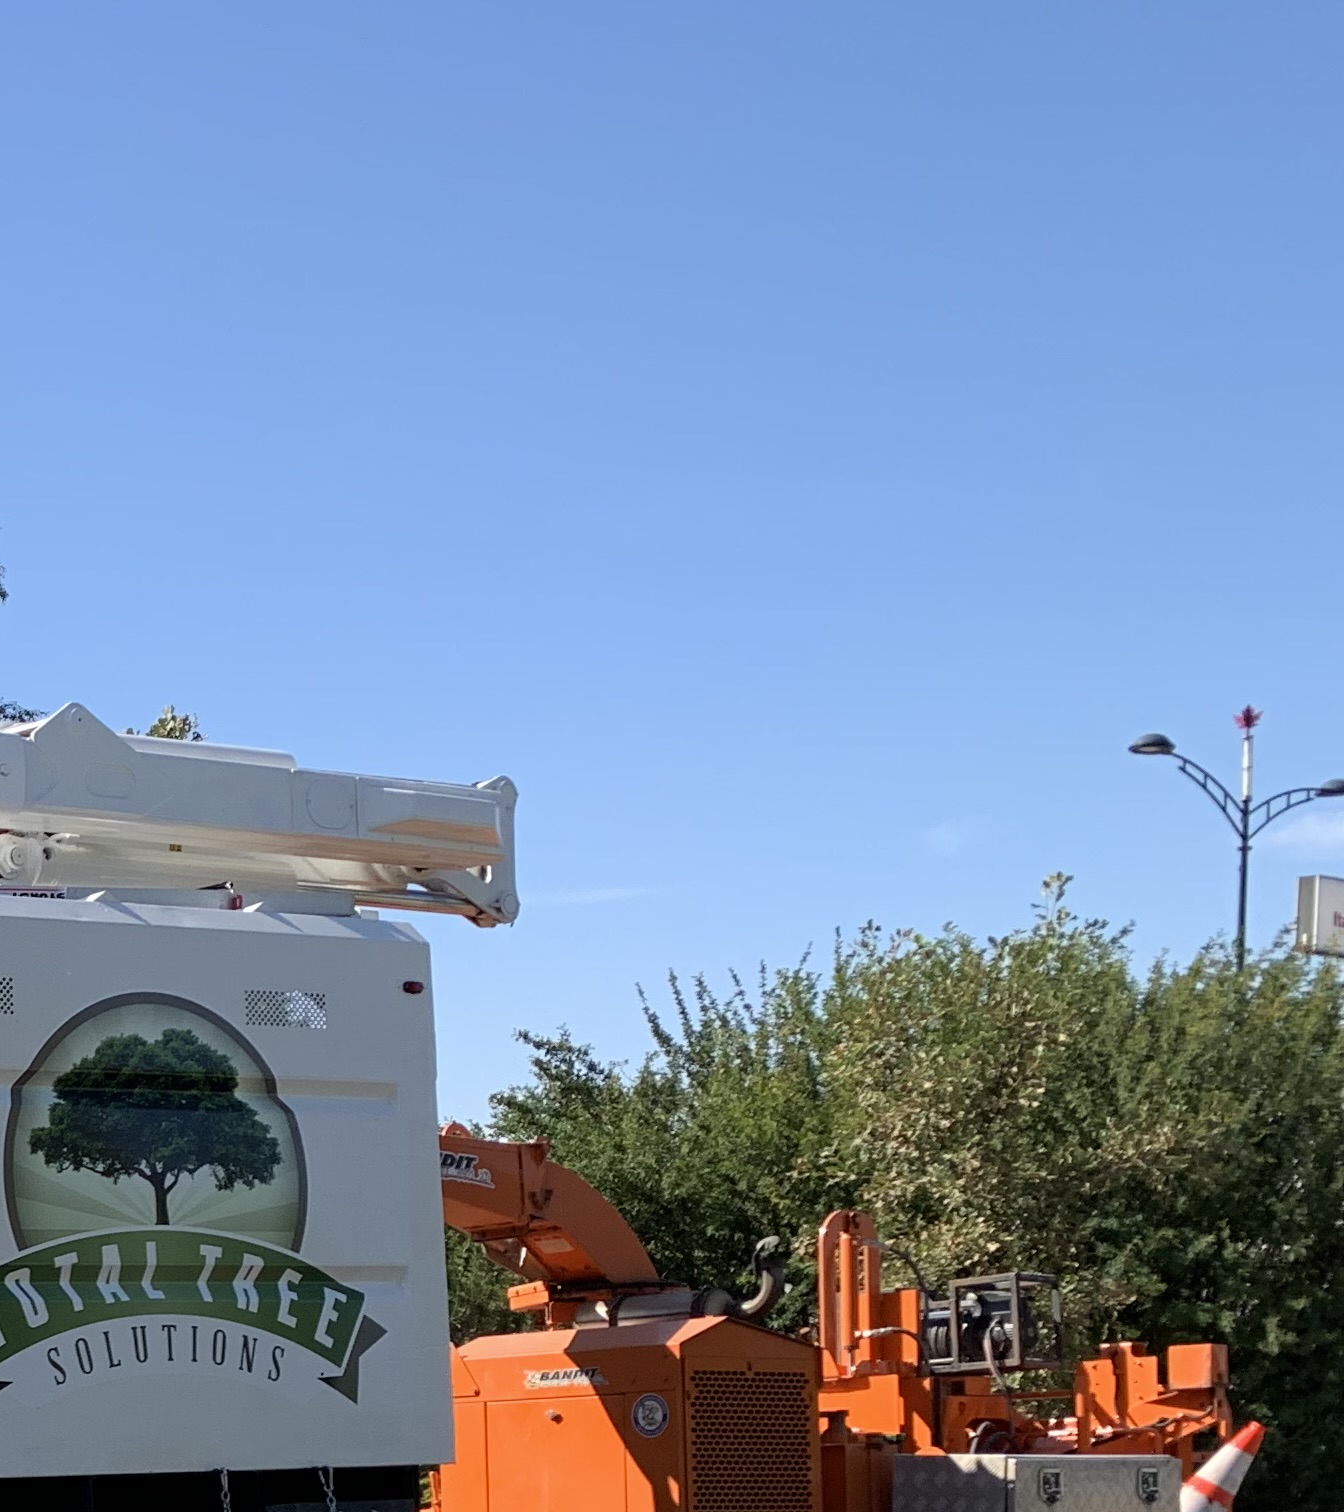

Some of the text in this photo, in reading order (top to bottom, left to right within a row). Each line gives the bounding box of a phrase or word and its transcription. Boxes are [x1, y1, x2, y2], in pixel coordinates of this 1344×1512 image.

[440, 1152, 477, 1169] DIT
[196, 1244, 347, 1348] TREE
[47, 1324, 285, 1385] SOLUTIONS
[539, 1367, 598, 1381] BANDIT
